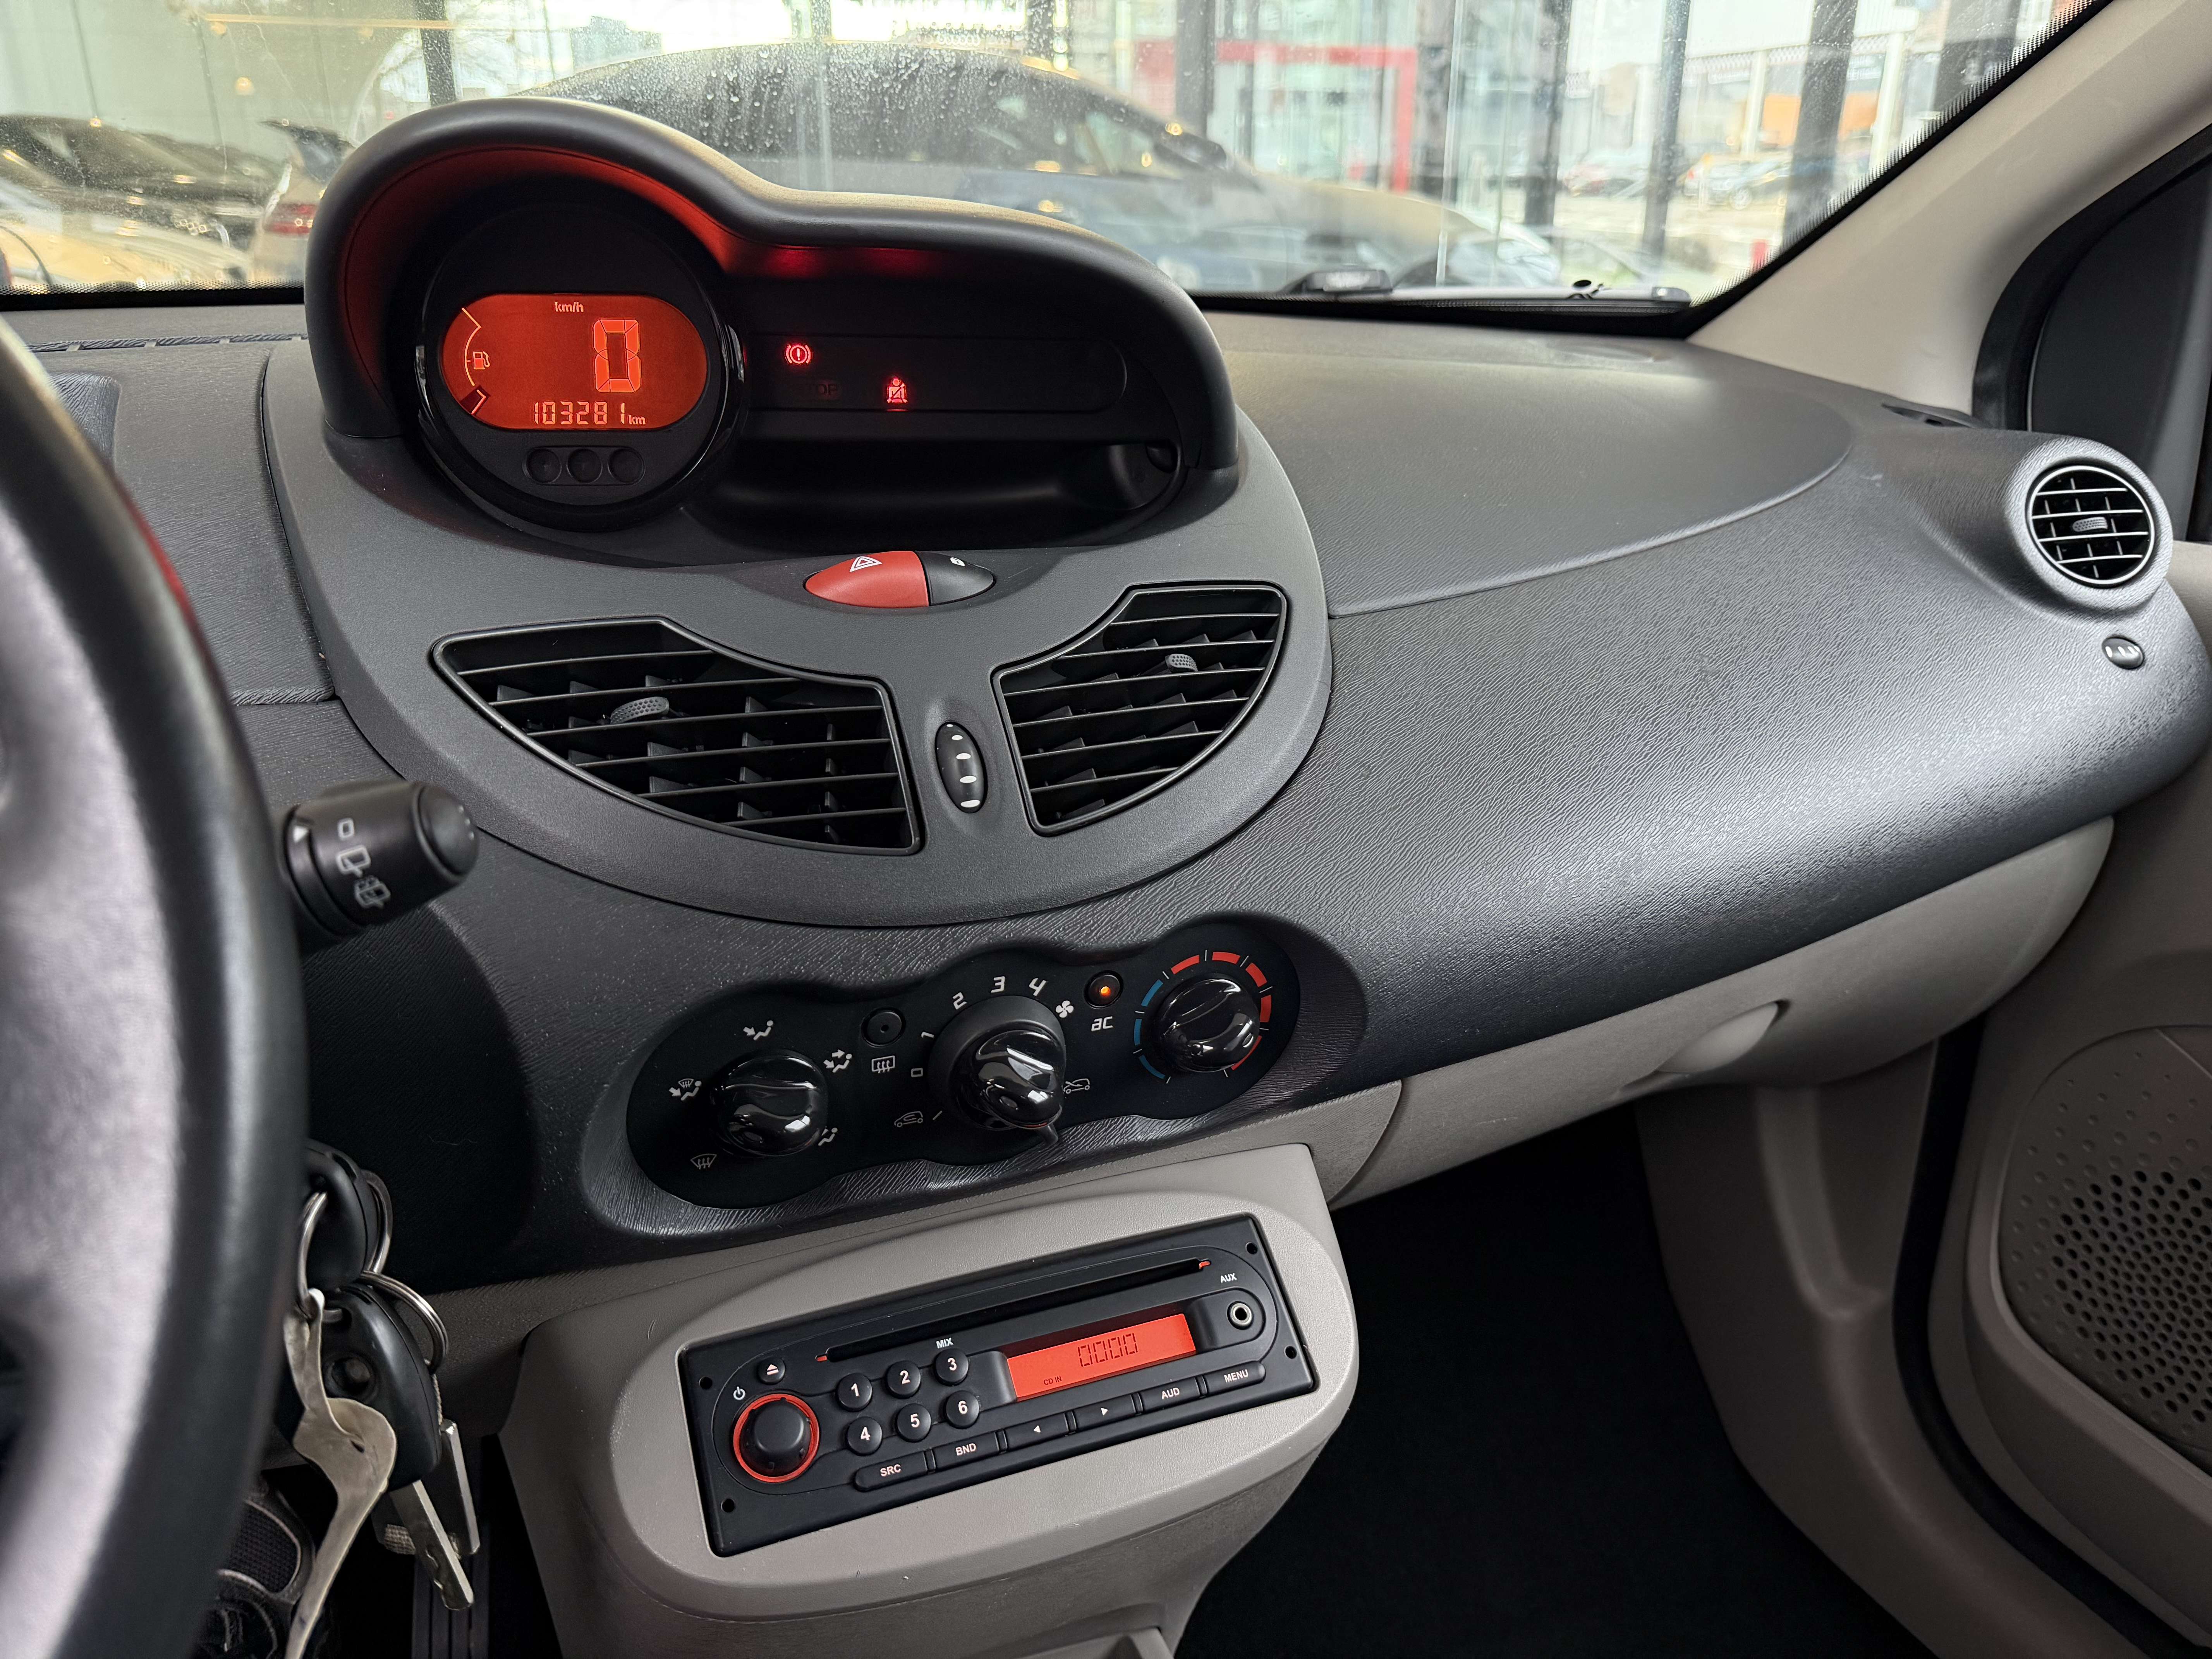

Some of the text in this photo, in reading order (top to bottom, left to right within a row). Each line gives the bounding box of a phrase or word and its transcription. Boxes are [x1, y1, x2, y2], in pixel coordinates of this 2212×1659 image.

[554, 301, 584, 313] km/h
[592, 319, 641, 393] 0
[628, 414, 646, 425] km
[990, 976, 1006, 993] 3
[1029, 978, 1047, 996] 4
[952, 992, 967, 1010] 2
[1220, 1273, 1237, 1283] AUX
[936, 1337, 954, 1349] MIX
[851, 1358, 957, 1397] 1 2 3
[1224, 1369, 1249, 1383] MENU
[1161, 1387, 1180, 1400] AUD
[860, 1400, 968, 1441] 4 5 6
[955, 1443, 977, 1456] BND
[879, 1464, 902, 1477] SRC
